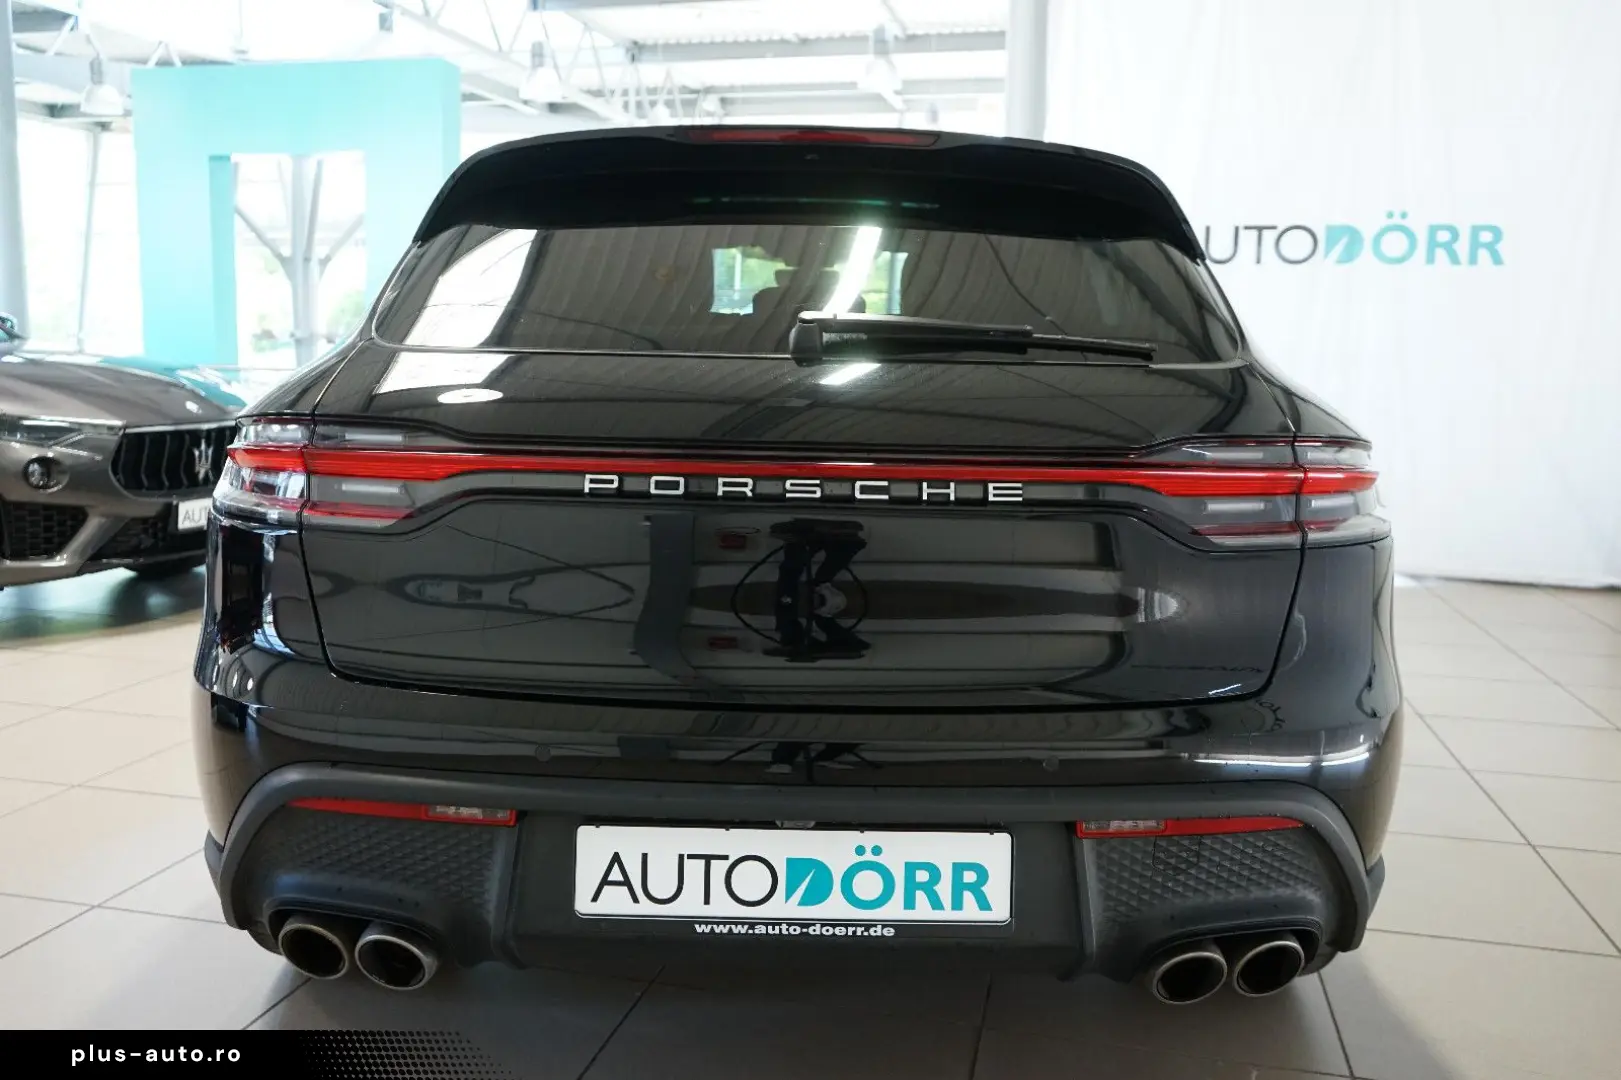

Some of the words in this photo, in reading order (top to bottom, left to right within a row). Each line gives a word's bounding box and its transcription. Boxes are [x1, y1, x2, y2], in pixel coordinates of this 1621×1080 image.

[1202, 210, 1504, 266] UTODÖRR
[584, 474, 1023, 501] PORSCHE
[694, 922, 895, 937] www.auto-doerr.de
